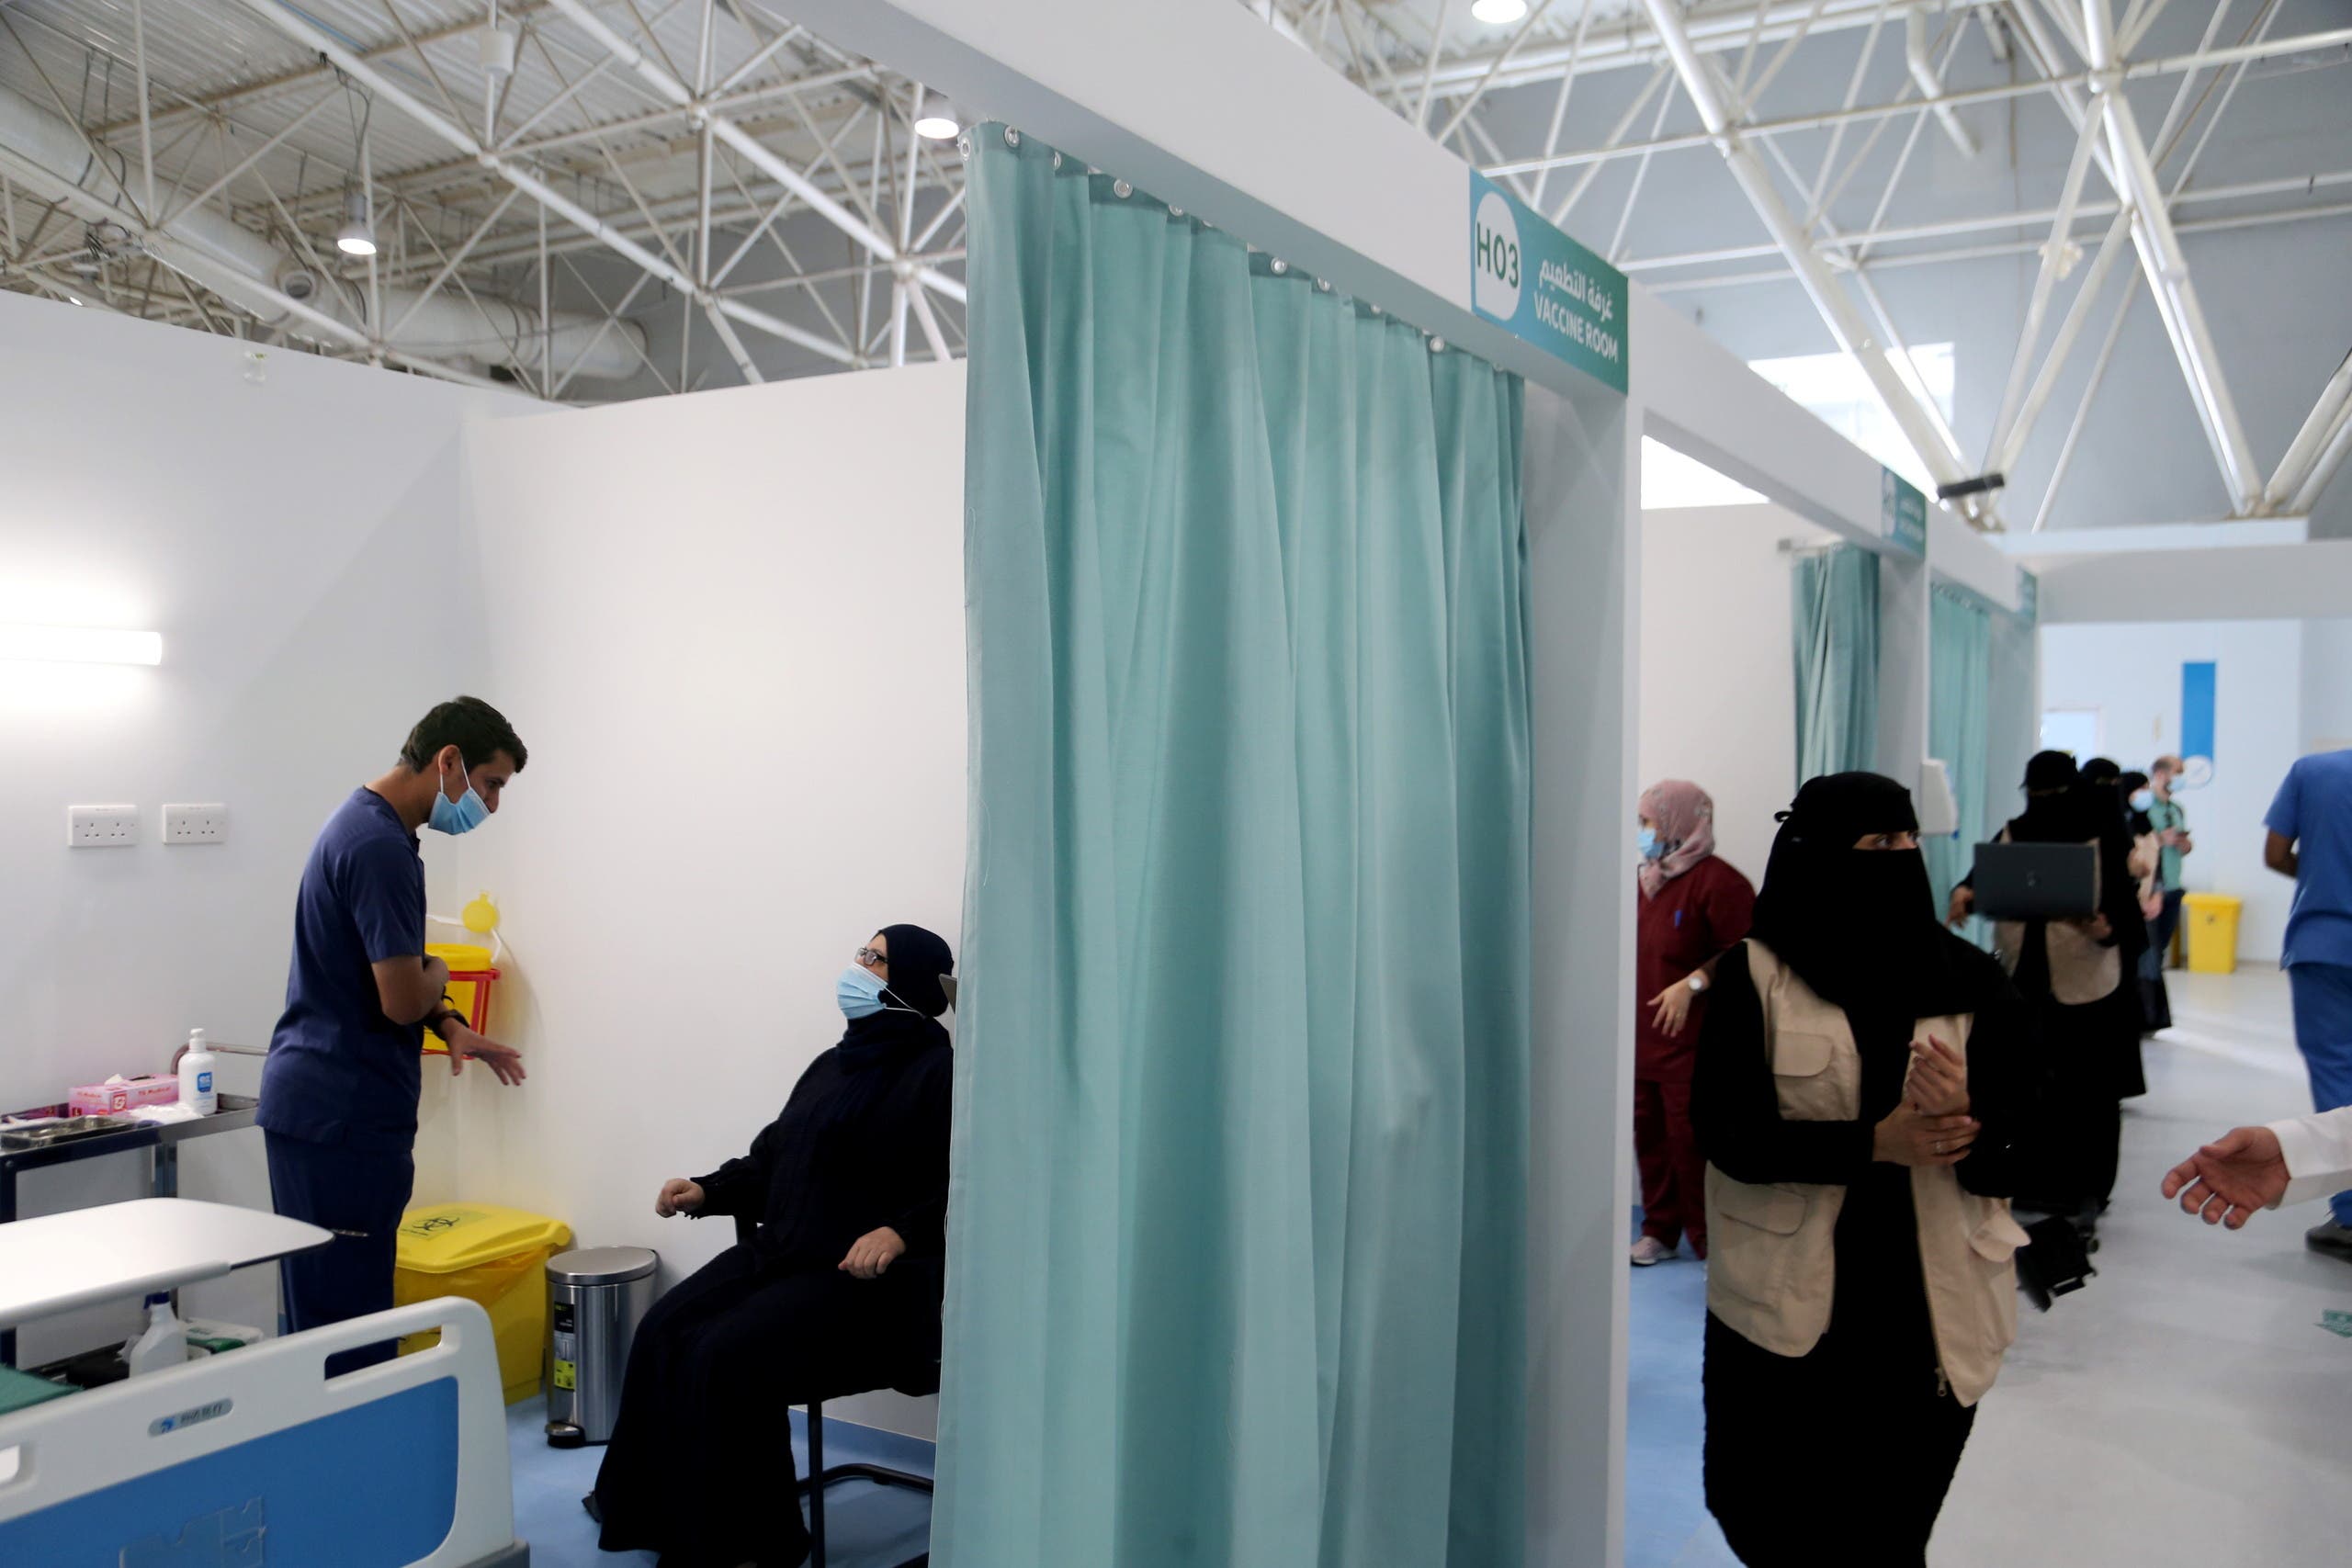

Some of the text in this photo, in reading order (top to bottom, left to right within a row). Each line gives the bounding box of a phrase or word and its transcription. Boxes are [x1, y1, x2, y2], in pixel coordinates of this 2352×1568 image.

[1539, 259, 1613, 322] غرفة التطعيم
[1533, 290, 1618, 363] VACCINE ROOM
